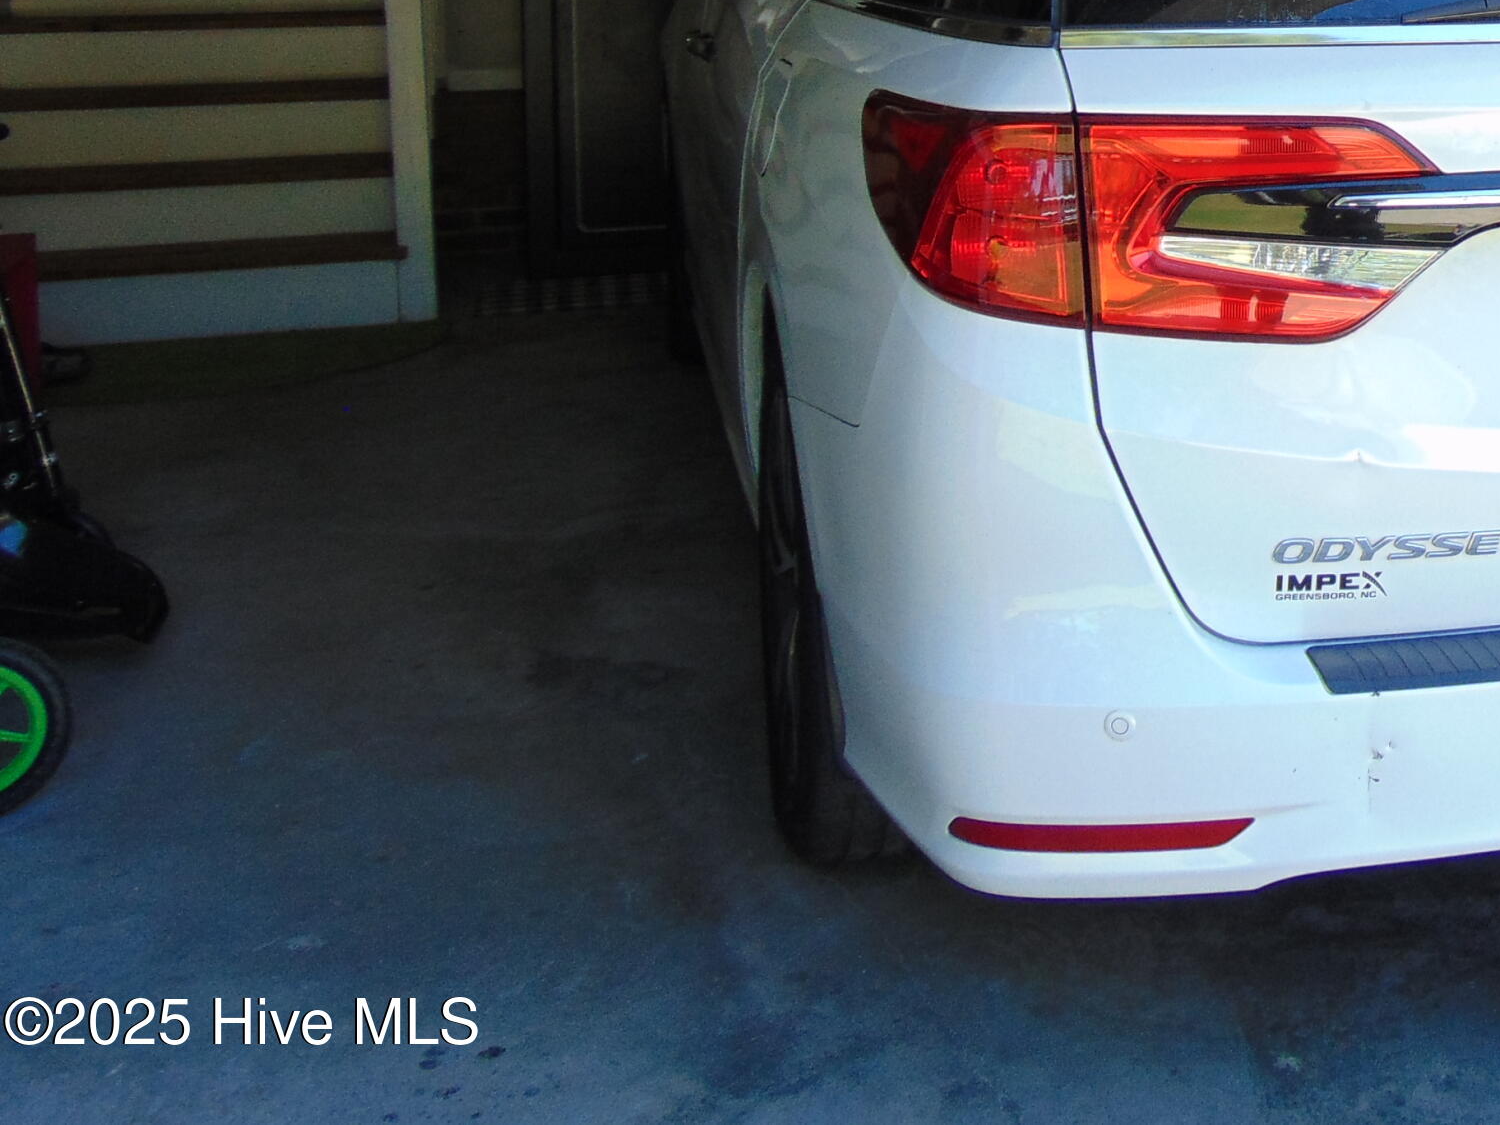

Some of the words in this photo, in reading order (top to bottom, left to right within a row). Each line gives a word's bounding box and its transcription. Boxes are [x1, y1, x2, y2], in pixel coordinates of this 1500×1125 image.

[1275, 570, 1388, 597] IMPEX
[1275, 592, 1357, 601] GREENSBORO,
[1360, 590, 1377, 599] NC
